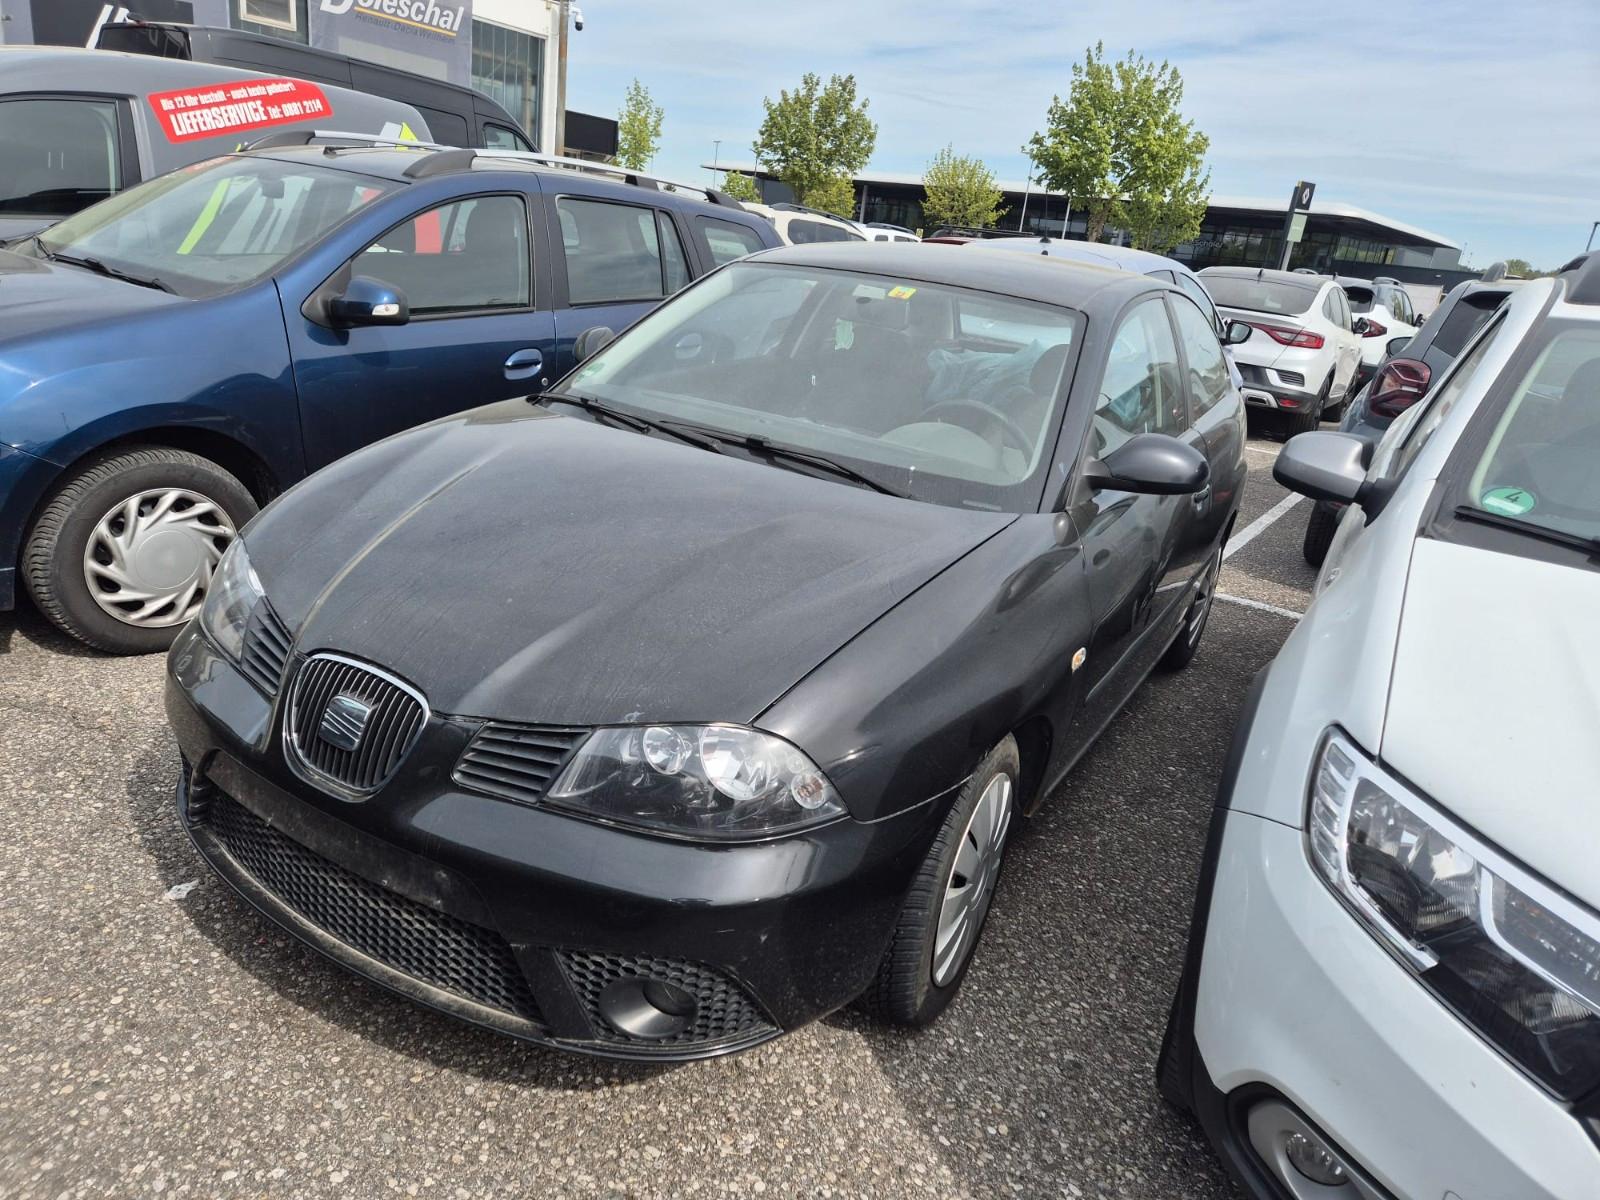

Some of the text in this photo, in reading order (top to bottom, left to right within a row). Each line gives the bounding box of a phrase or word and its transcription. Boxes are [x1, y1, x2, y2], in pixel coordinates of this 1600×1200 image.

[174, 96, 184, 109] 12
[184, 94, 199, 107] Uhr
[169, 101, 268, 136] LIEFERSERVICE
[302, 98, 323, 114] 2114
[1504, 491, 1523, 503] 4
